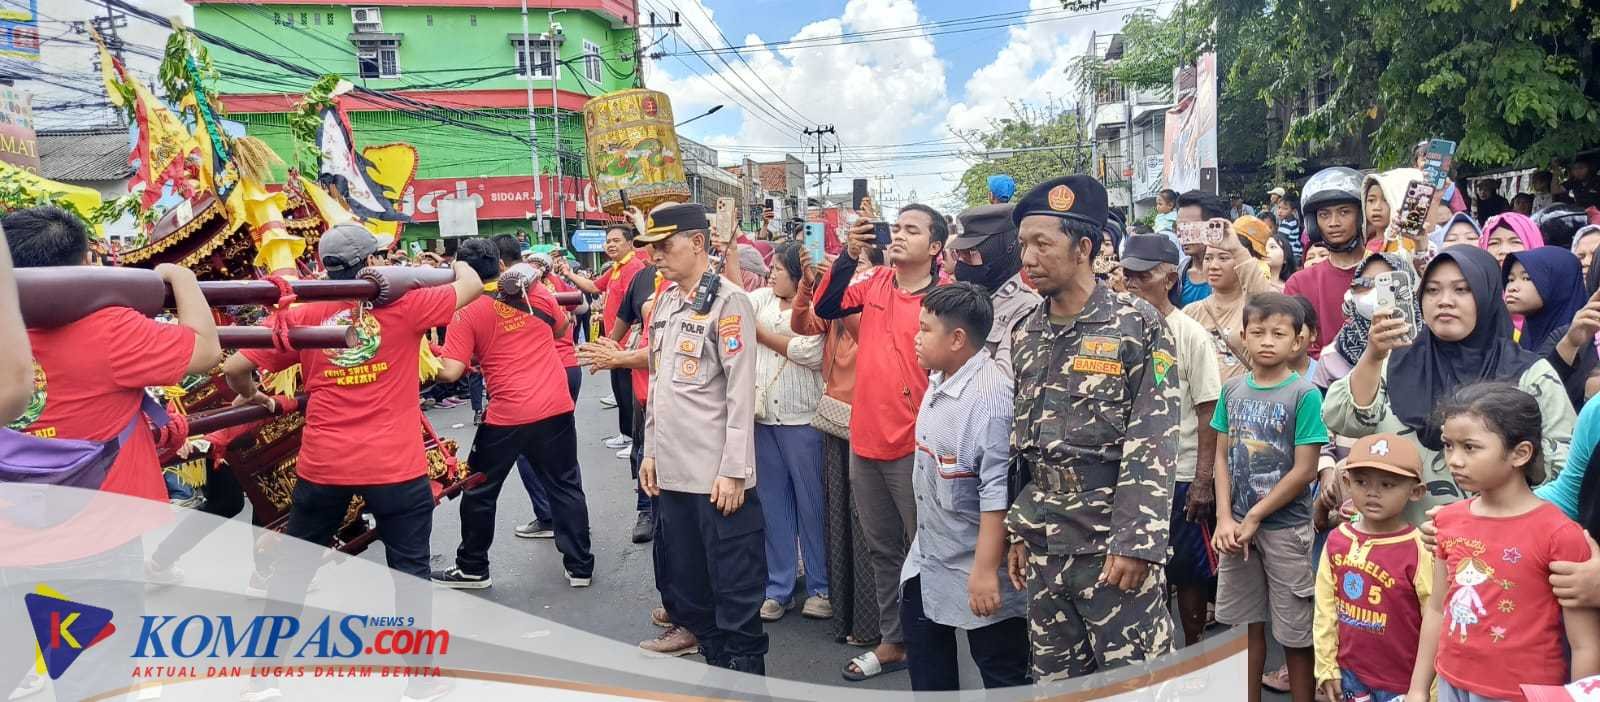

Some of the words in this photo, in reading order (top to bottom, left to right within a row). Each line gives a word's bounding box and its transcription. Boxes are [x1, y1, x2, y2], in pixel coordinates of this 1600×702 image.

[681, 321, 705, 335] POLRI
[372, 361, 388, 373] BIO
[1074, 359, 1119, 374] BANSER
[337, 372, 377, 385] KRIAN
[1368, 585, 1382, 605] 5
